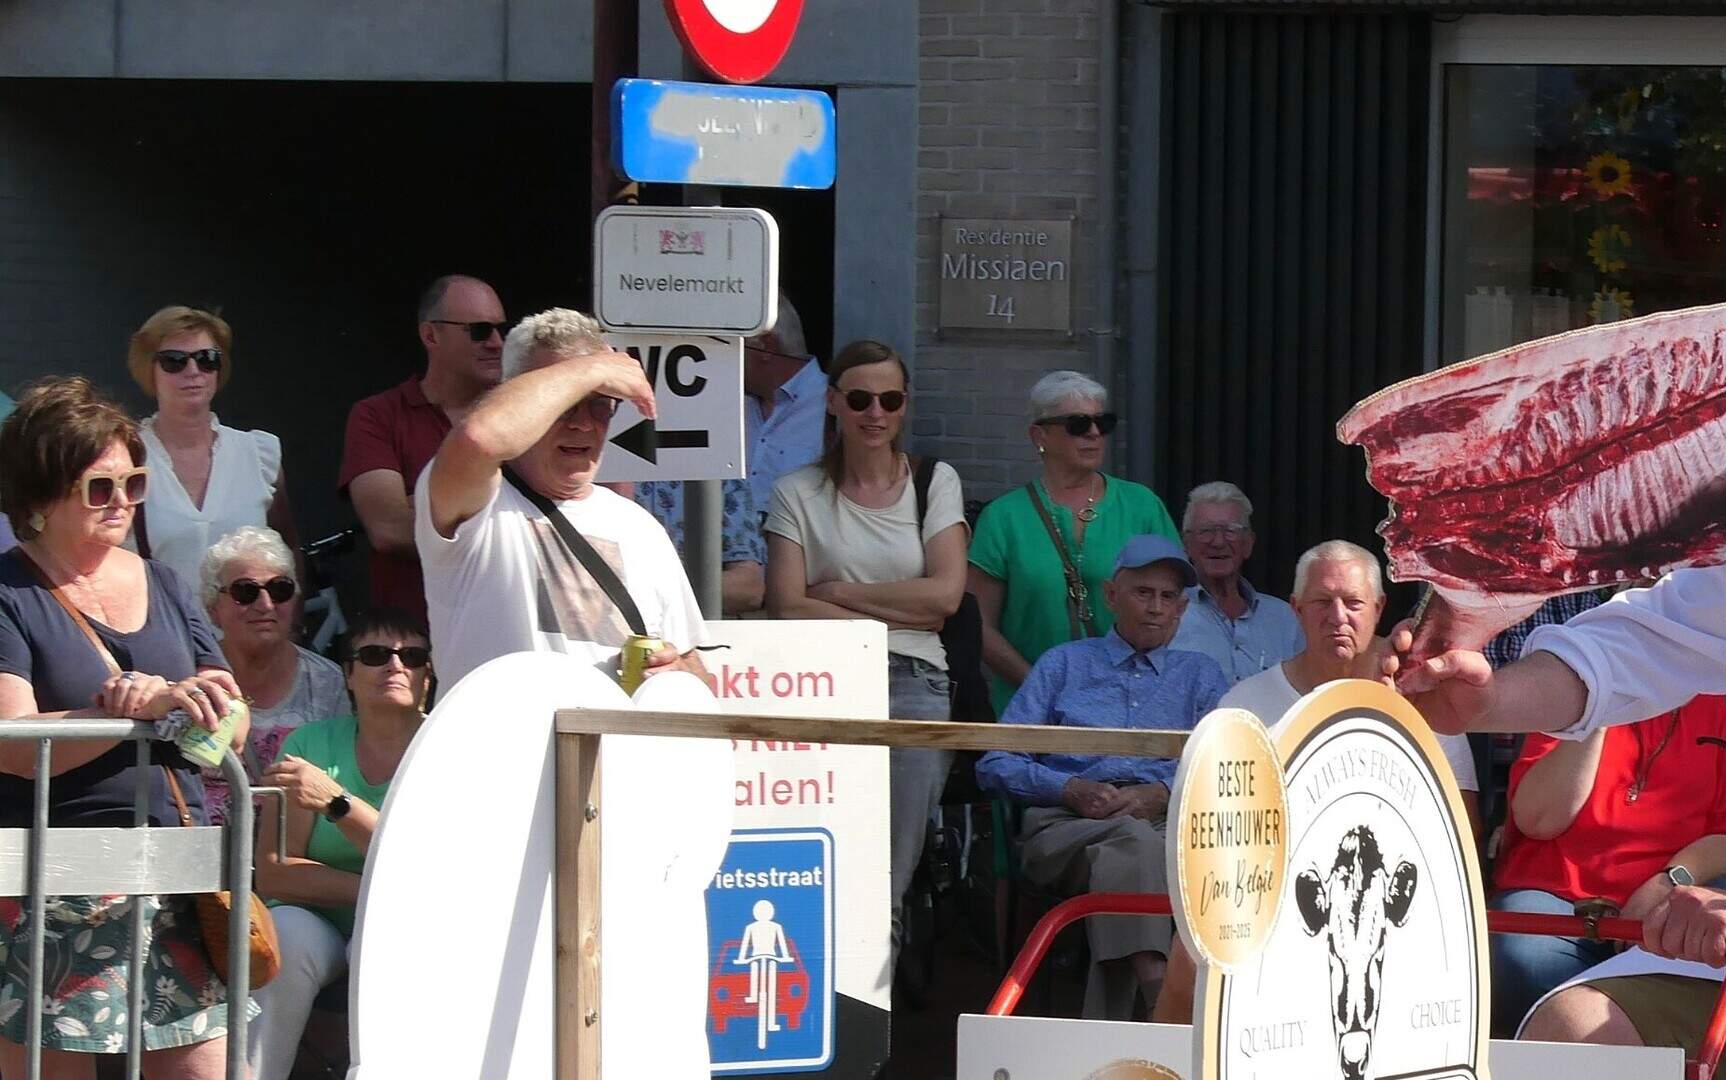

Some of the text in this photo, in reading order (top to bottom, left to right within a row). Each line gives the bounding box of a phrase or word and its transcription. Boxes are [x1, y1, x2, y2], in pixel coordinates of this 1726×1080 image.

[954, 227, 1049, 246] Residentie
[942, 253, 1064, 281] Missiaen
[619, 273, 745, 295] Nevelemarkt
[986, 294, 1016, 324] 14
[771, 671, 834, 698] om
[1218, 760, 1256, 798] BESTE
[1370, 749, 1417, 811] FRESH
[1190, 808, 1281, 850] BEENHOUWER
[1239, 998, 1463, 1059] QUALITY CHOICE
